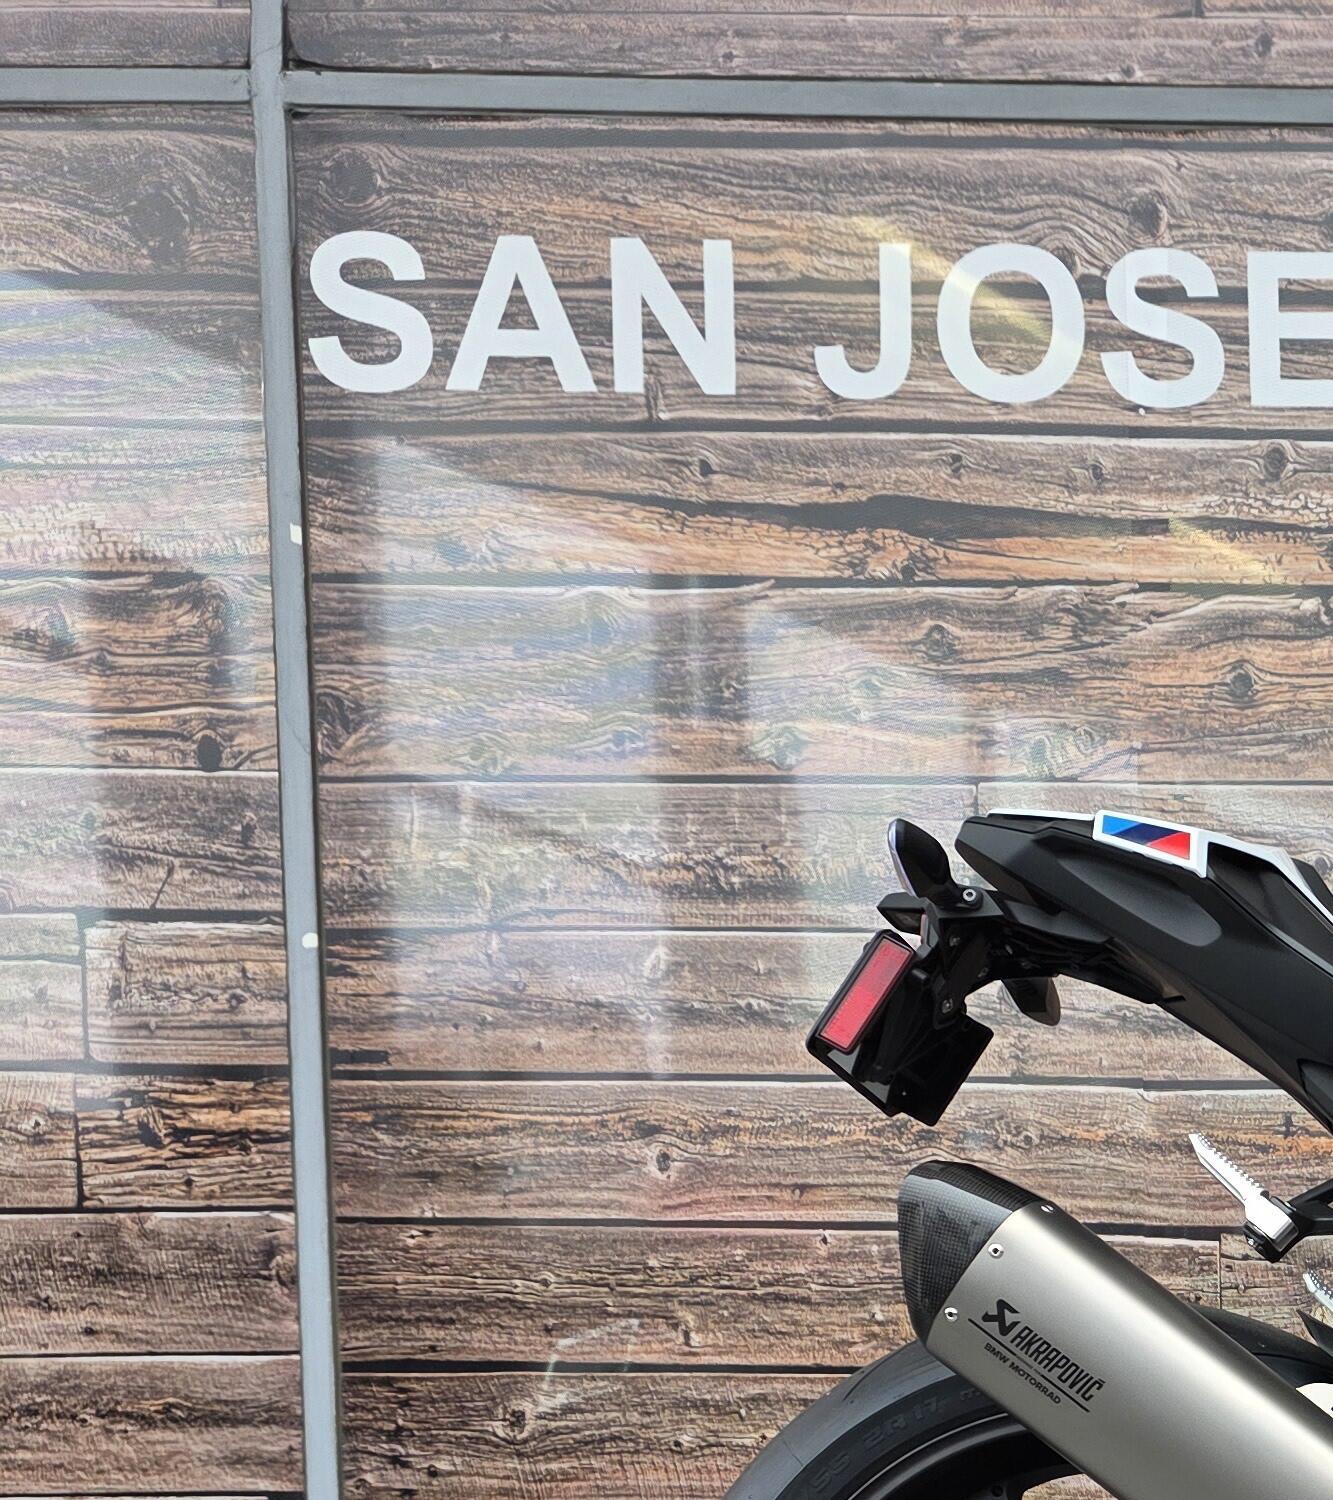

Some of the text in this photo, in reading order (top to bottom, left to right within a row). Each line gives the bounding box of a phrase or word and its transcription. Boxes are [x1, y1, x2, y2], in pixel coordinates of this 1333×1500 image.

[308, 230, 737, 395] SAN
[983, 1342, 1011, 1364] BMW
[1008, 1361, 1062, 1404] MOTORRAD
